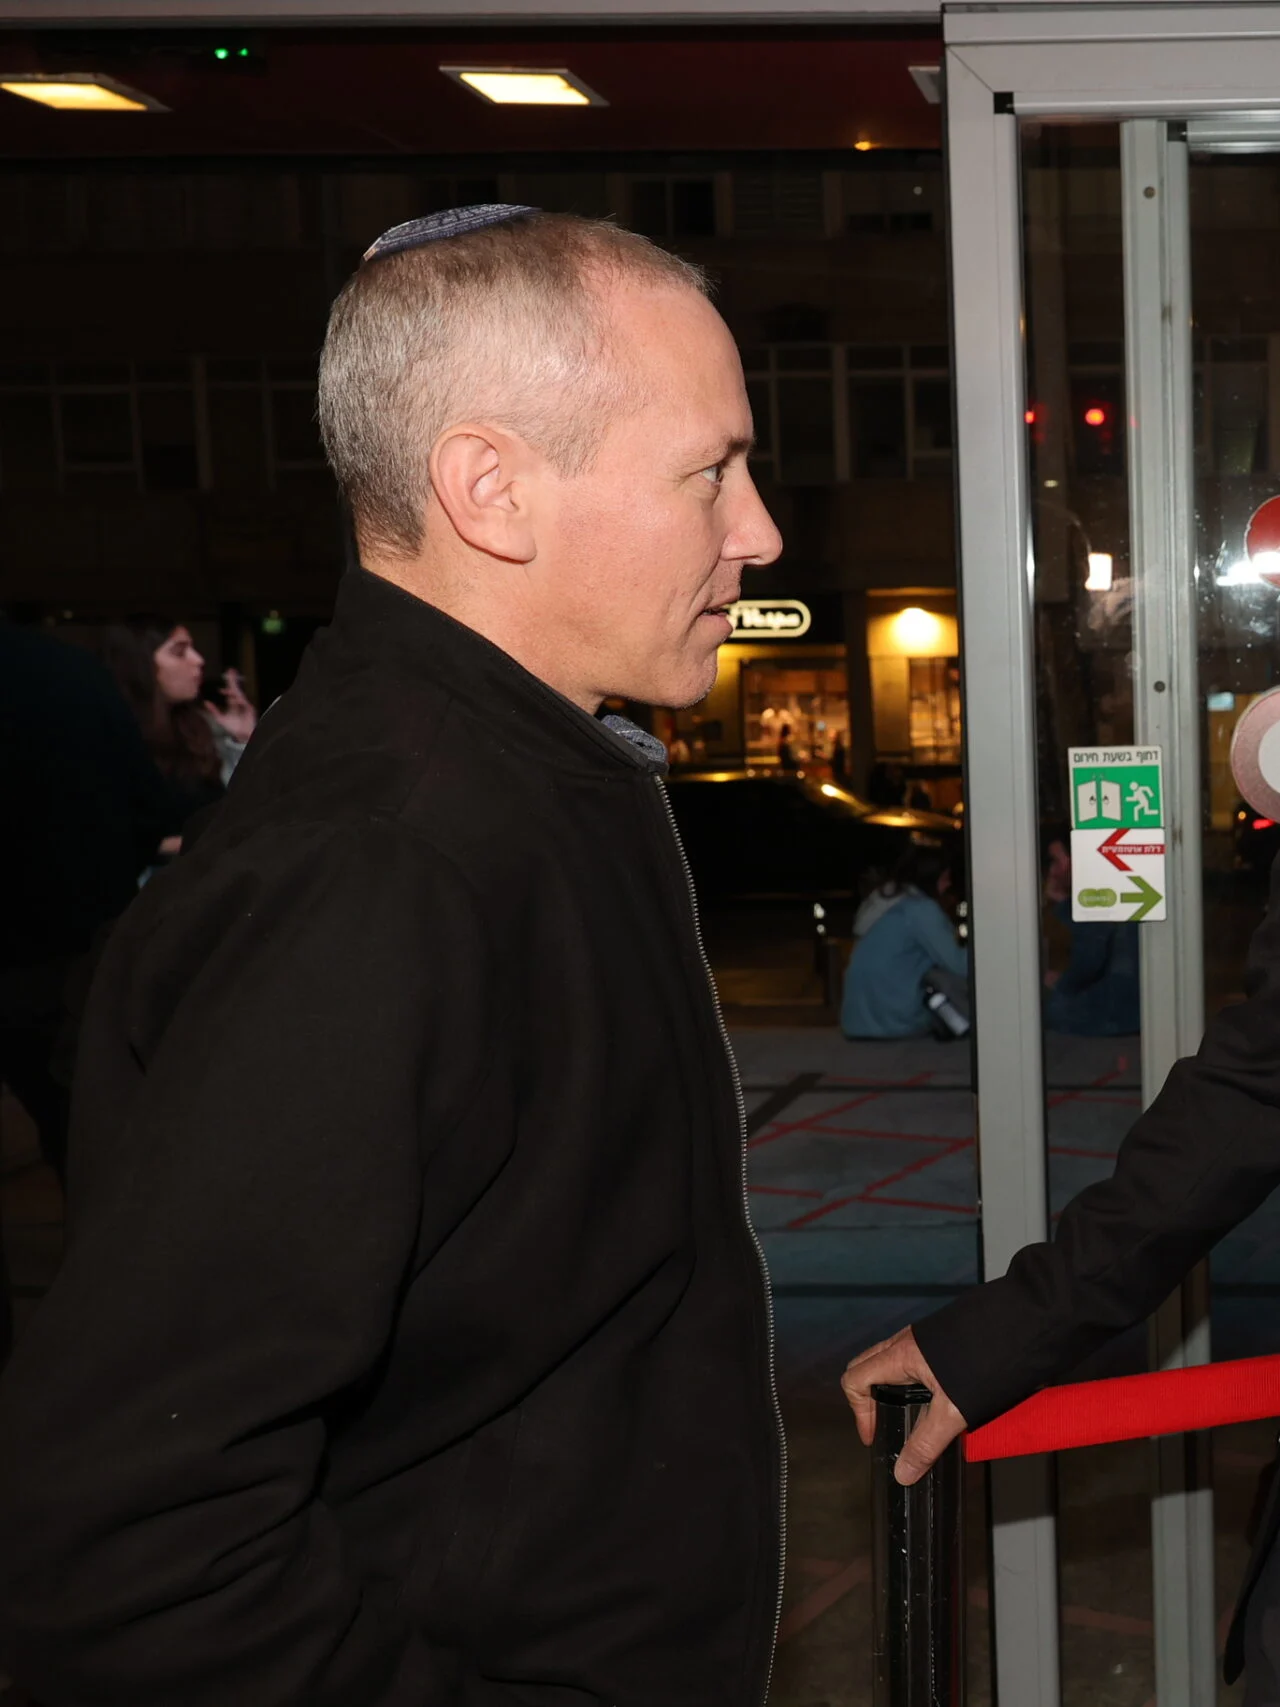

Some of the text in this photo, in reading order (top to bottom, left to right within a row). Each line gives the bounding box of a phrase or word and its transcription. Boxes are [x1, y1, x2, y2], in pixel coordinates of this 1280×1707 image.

[1073, 750, 1158, 763] דחוף בשעת חירום
